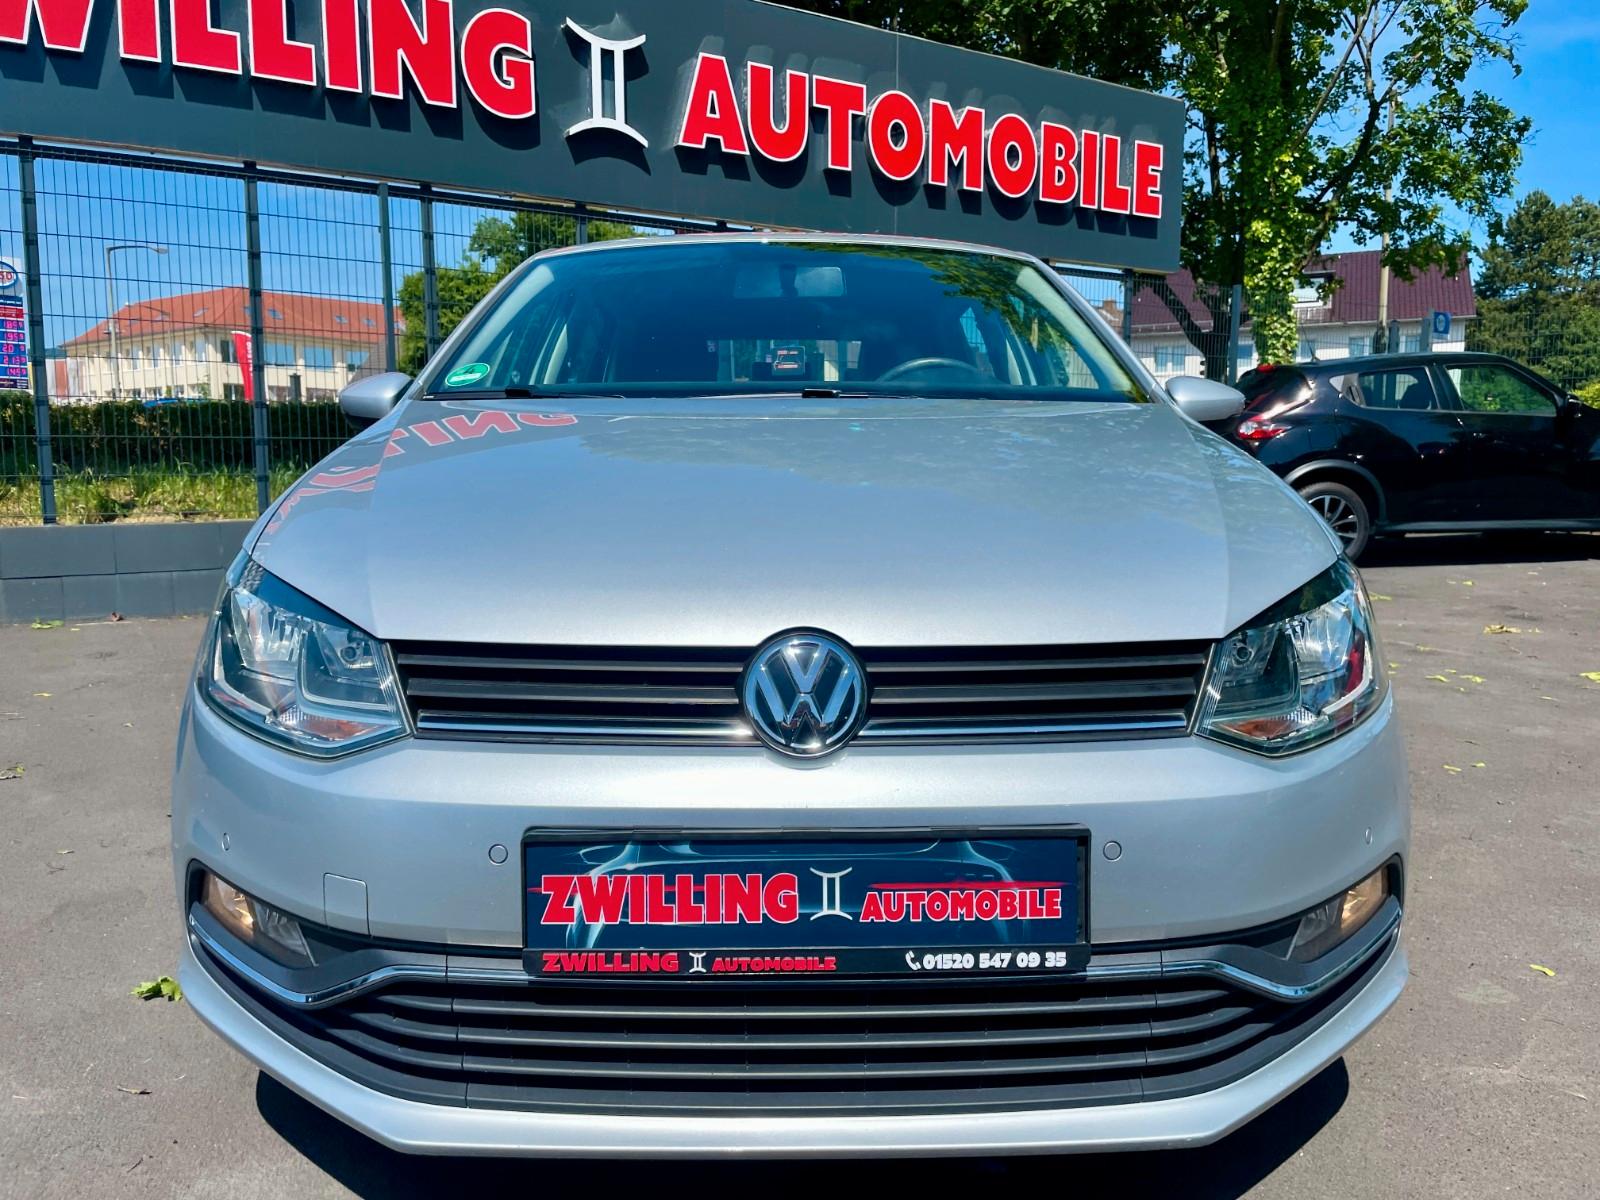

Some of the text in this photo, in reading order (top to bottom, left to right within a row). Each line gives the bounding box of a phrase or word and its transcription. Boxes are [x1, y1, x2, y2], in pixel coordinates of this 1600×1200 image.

[673, 52, 1164, 219] AUTOMOBILE
[540, 873, 1062, 925] ZWILLING AUTOMOBILE
[542, 952, 837, 973] ZWILLING AUTOMOBILE
[922, 951, 1067, 970] 01520 547 09 35
